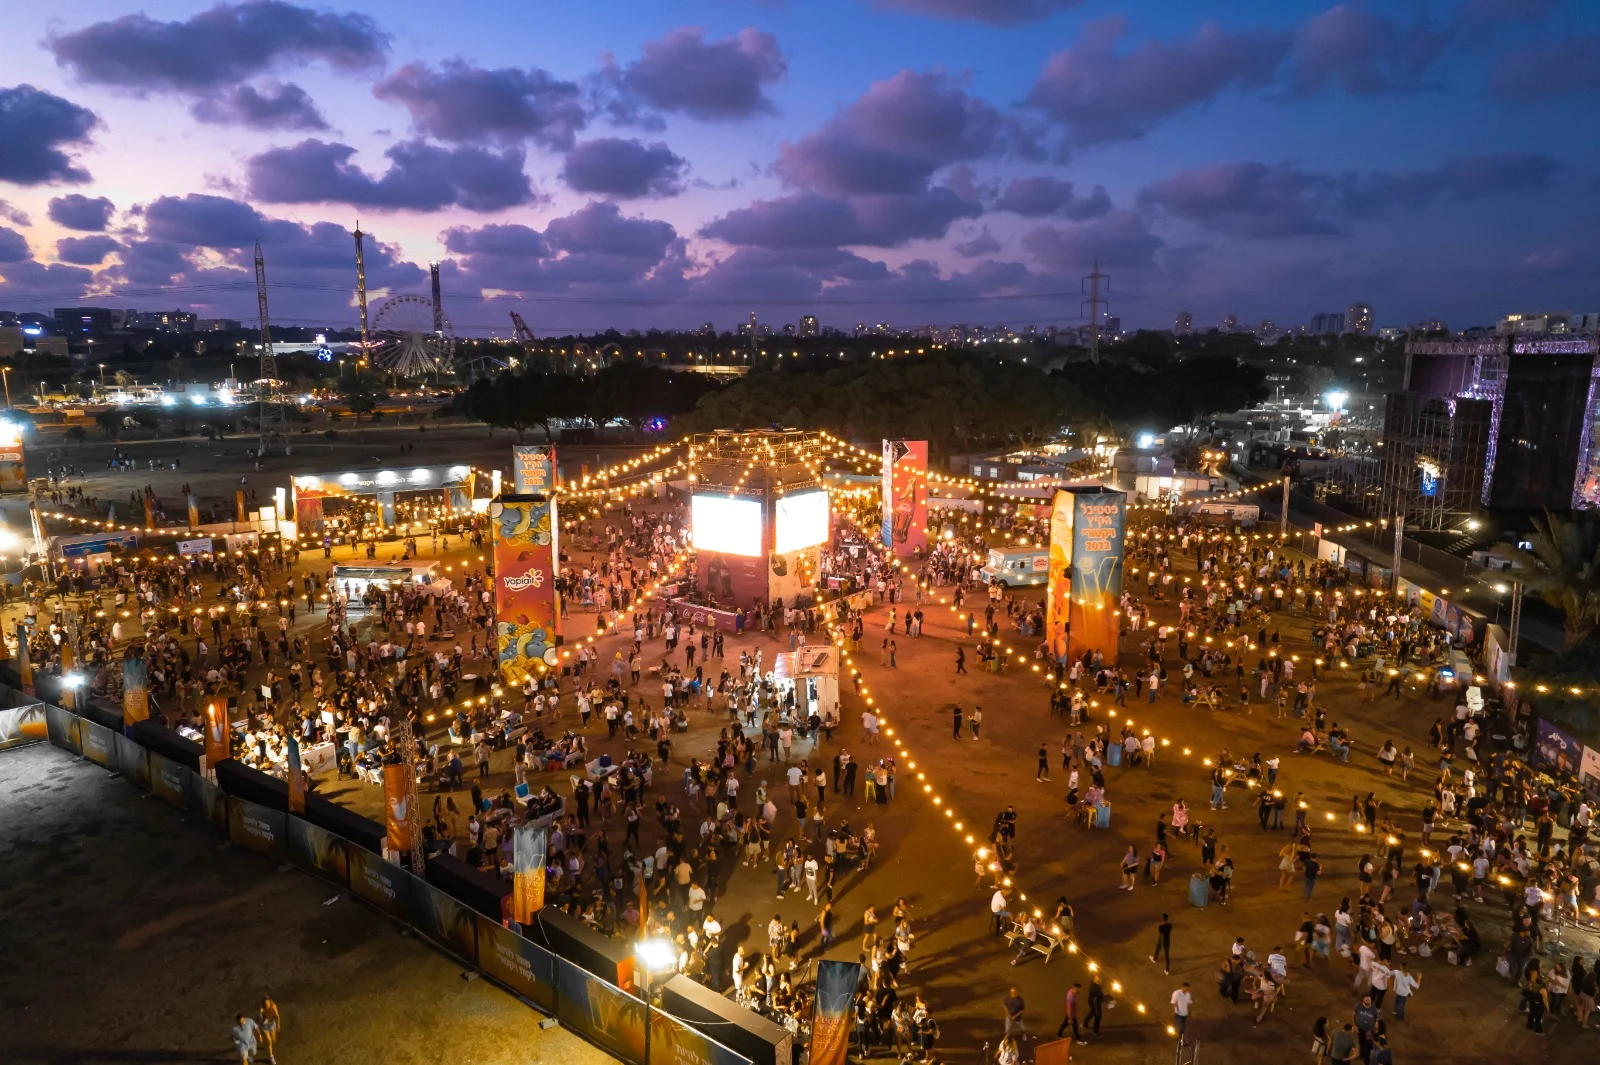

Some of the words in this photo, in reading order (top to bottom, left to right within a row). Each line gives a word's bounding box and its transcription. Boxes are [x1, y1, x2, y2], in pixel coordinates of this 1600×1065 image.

[1080, 502, 1119, 515] פסטיבל
[1086, 515, 1113, 528] הקיץ
[1081, 527, 1117, 541] ויקטורי
[1084, 540, 1112, 551] 2022
[504, 576, 535, 588] Yoplait
